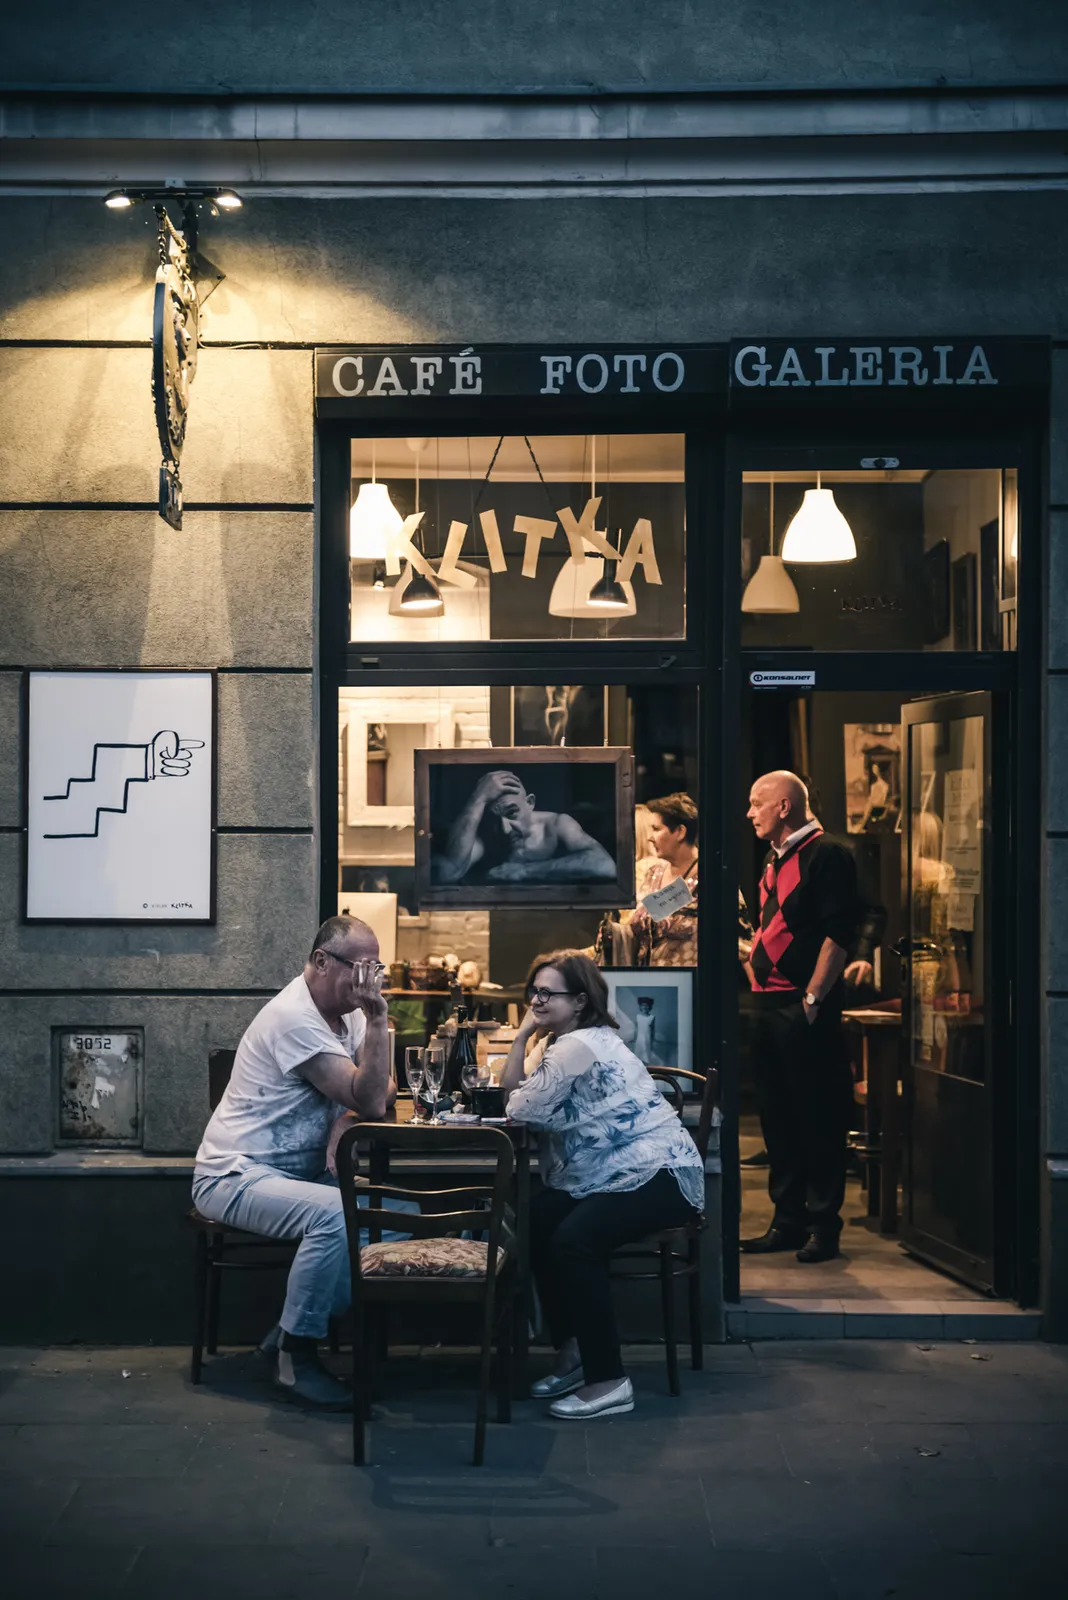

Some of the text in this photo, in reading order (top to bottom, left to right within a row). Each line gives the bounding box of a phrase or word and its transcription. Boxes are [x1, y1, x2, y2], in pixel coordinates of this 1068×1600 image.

[332, 345, 998, 396] CAFÉ FOTO GALERIA
[385, 496, 663, 589] KLITKA
[76, 1037, 112, 1050] 3052
